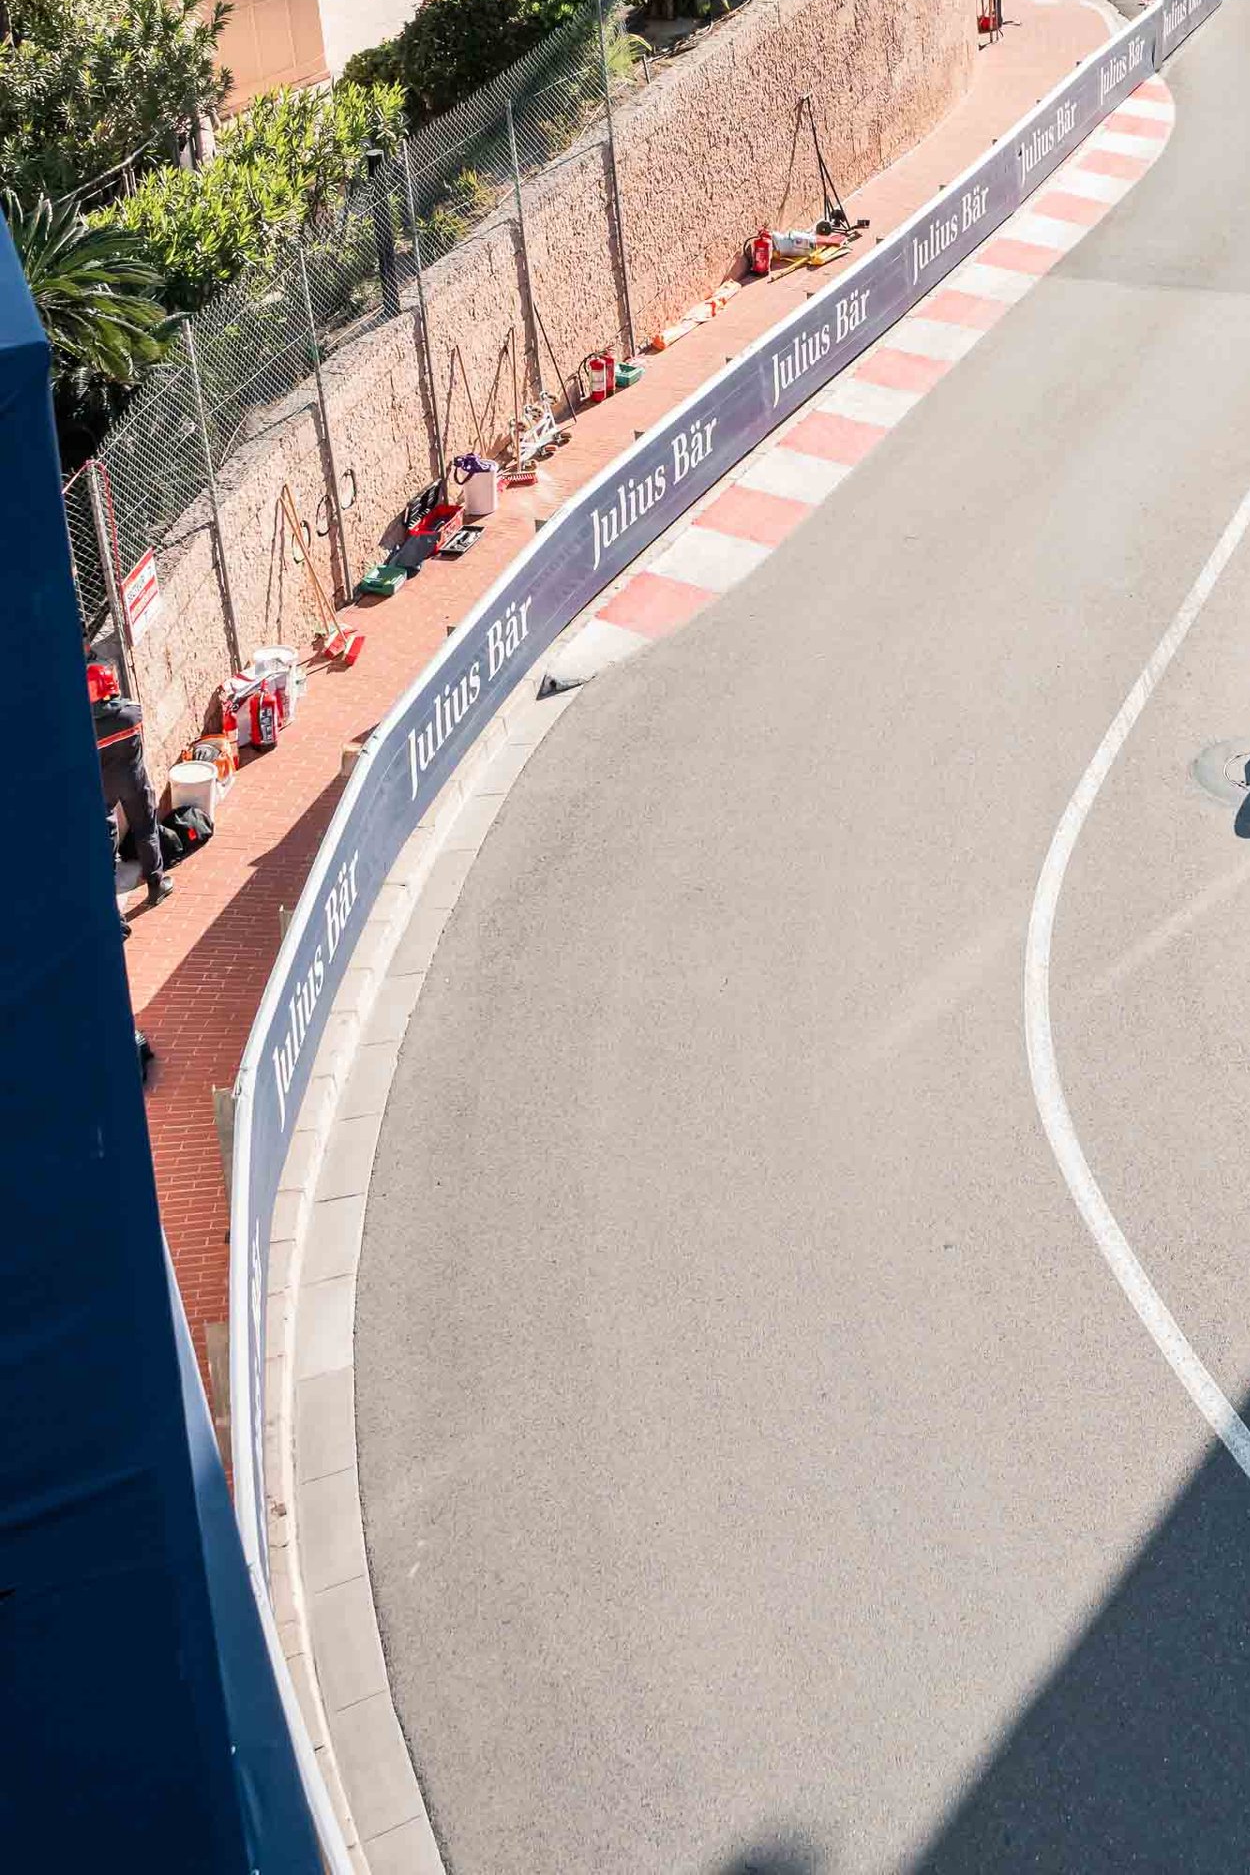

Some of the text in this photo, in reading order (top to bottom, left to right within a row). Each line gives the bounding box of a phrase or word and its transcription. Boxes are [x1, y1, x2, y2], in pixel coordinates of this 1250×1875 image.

[1100, 36, 1145, 106] Julius Bär
[1017, 99, 1077, 188] Julius Bär
[912, 185, 991, 286] Julius Bär
[770, 285, 871, 409] Julius Bär
[590, 463, 666, 571] Julius
[672, 415, 719, 487] Bär
[406, 594, 533, 801] Julius Bär
[271, 850, 361, 1134] Julius Bär
